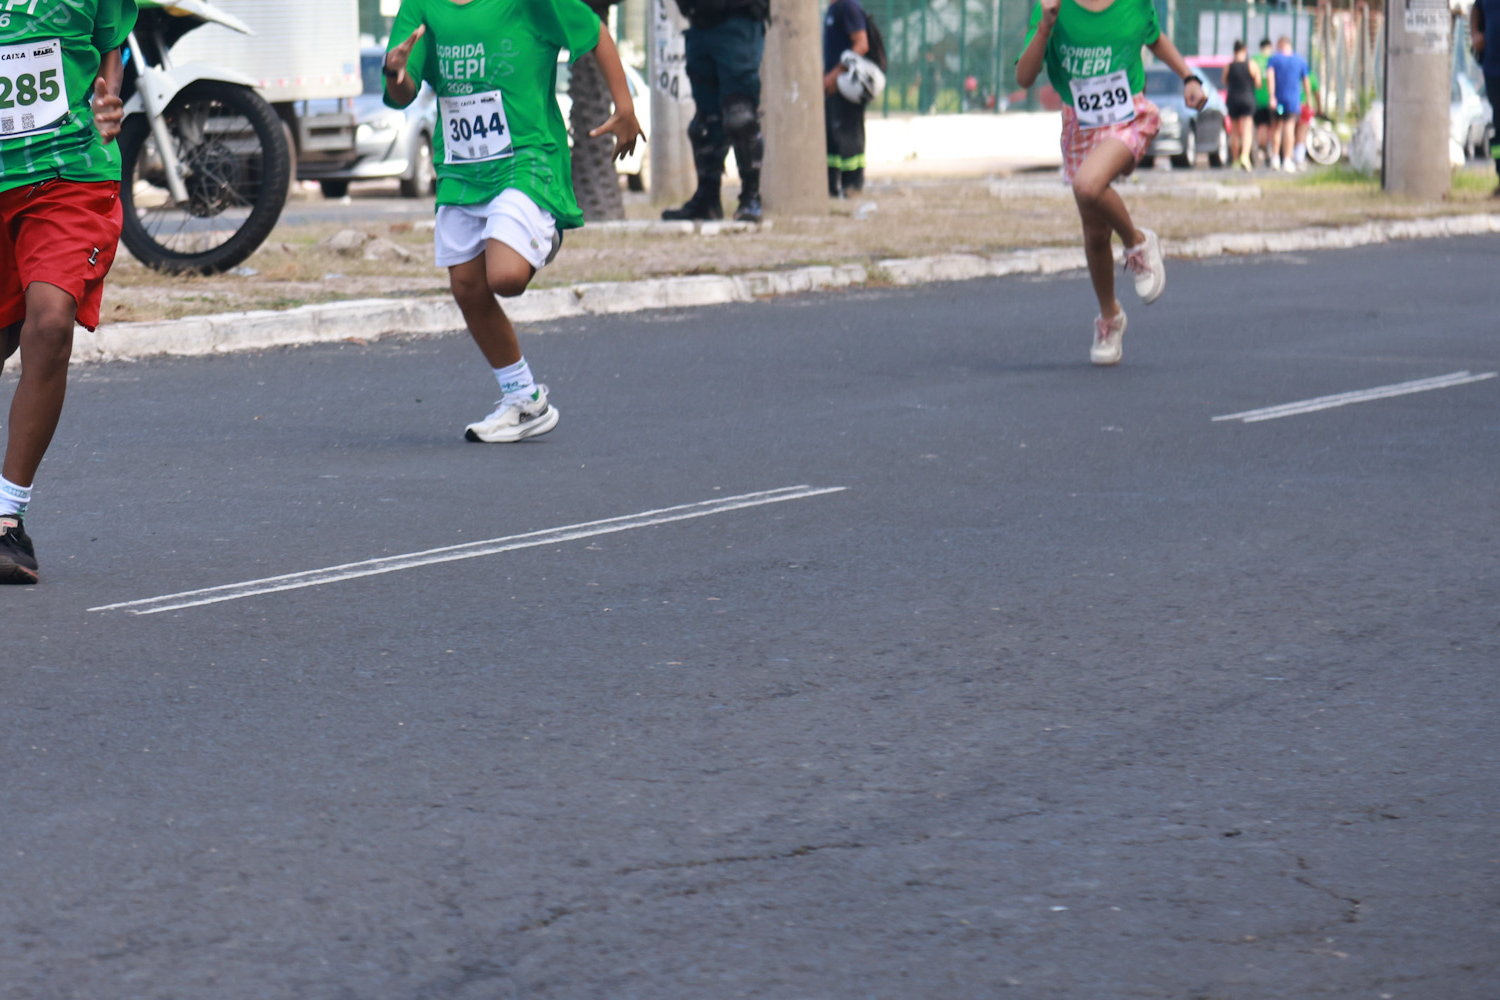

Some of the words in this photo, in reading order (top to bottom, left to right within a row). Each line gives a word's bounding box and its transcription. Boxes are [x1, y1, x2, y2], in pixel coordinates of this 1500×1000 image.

[1, 52, 26, 61] CAIXA
[1061, 56, 1112, 76] ALEPI
[439, 57, 486, 80] ALEPI
[447, 82, 474, 94] 2026
[1078, 87, 1128, 112] 6239
[450, 112, 505, 142] 3044
